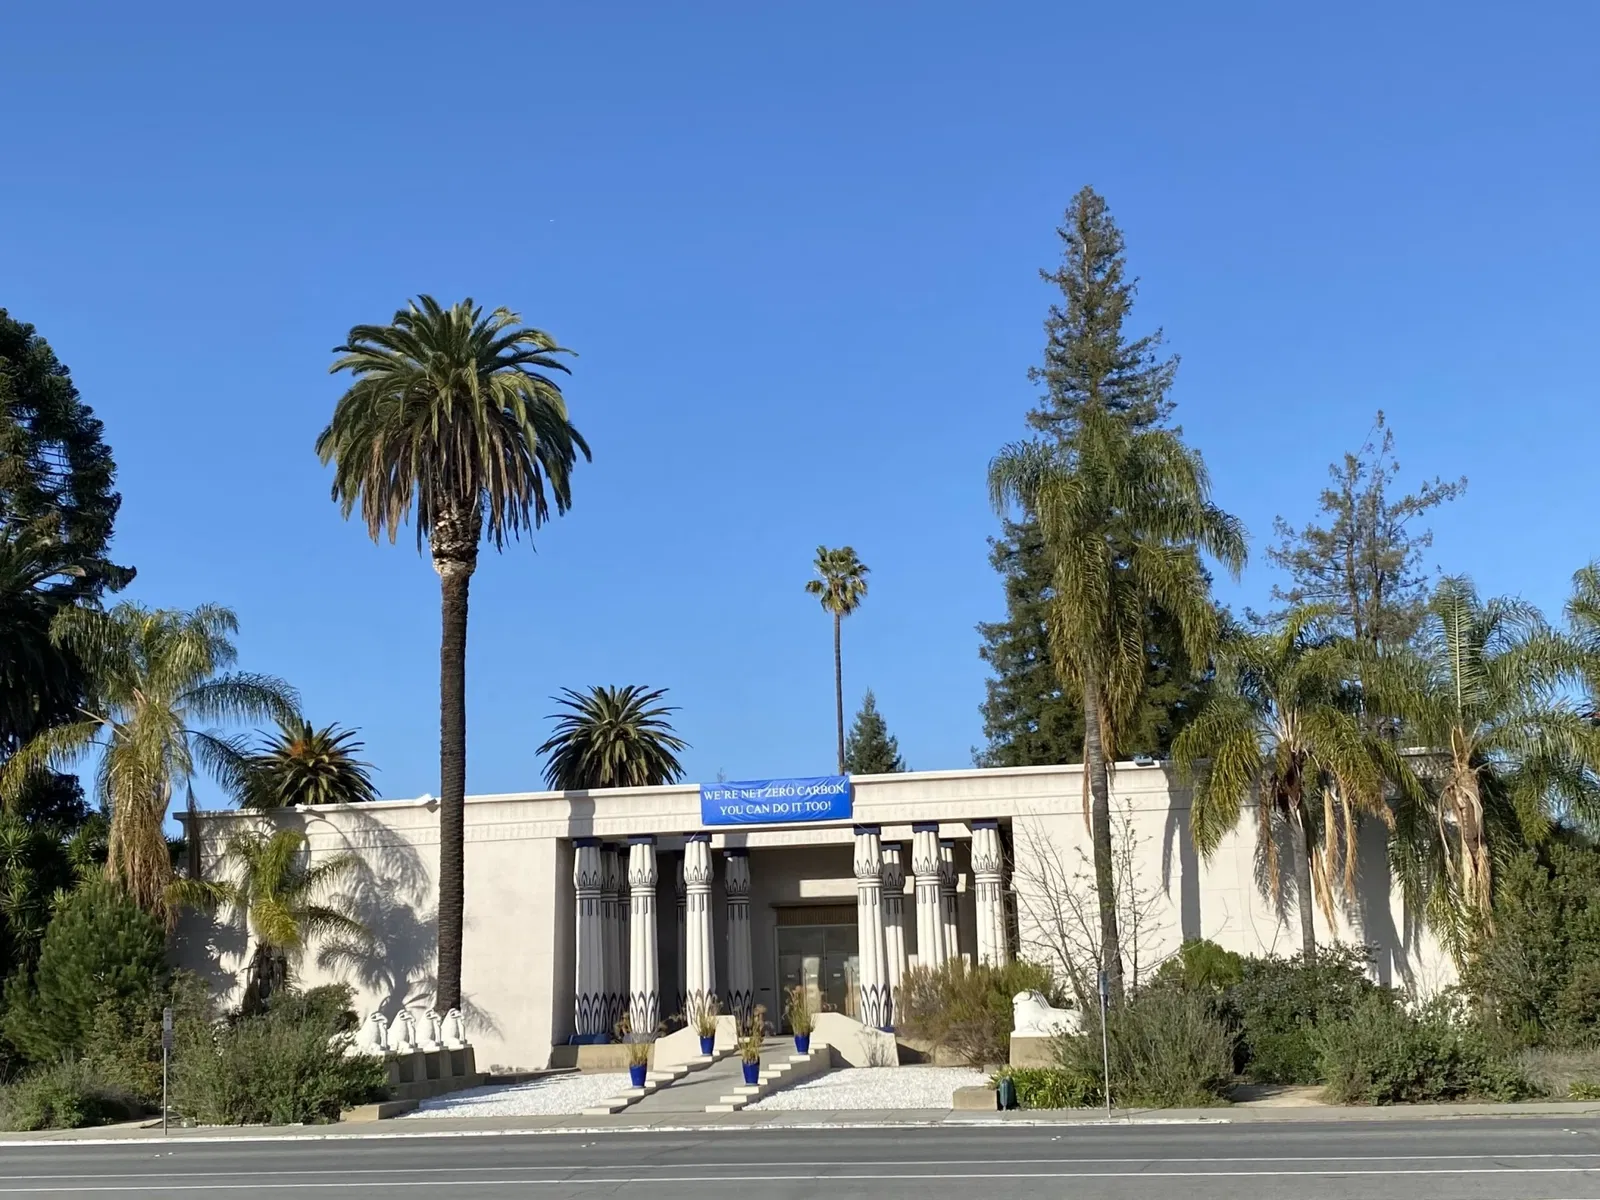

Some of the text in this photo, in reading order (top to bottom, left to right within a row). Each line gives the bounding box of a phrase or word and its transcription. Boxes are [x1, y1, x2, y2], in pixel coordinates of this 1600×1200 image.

[741, 788, 763, 799] NET
[765, 786, 795, 798] ZERO
[797, 784, 848, 796] CARBON.
[720, 800, 831, 816] YOU CAN DO IT TOO!
